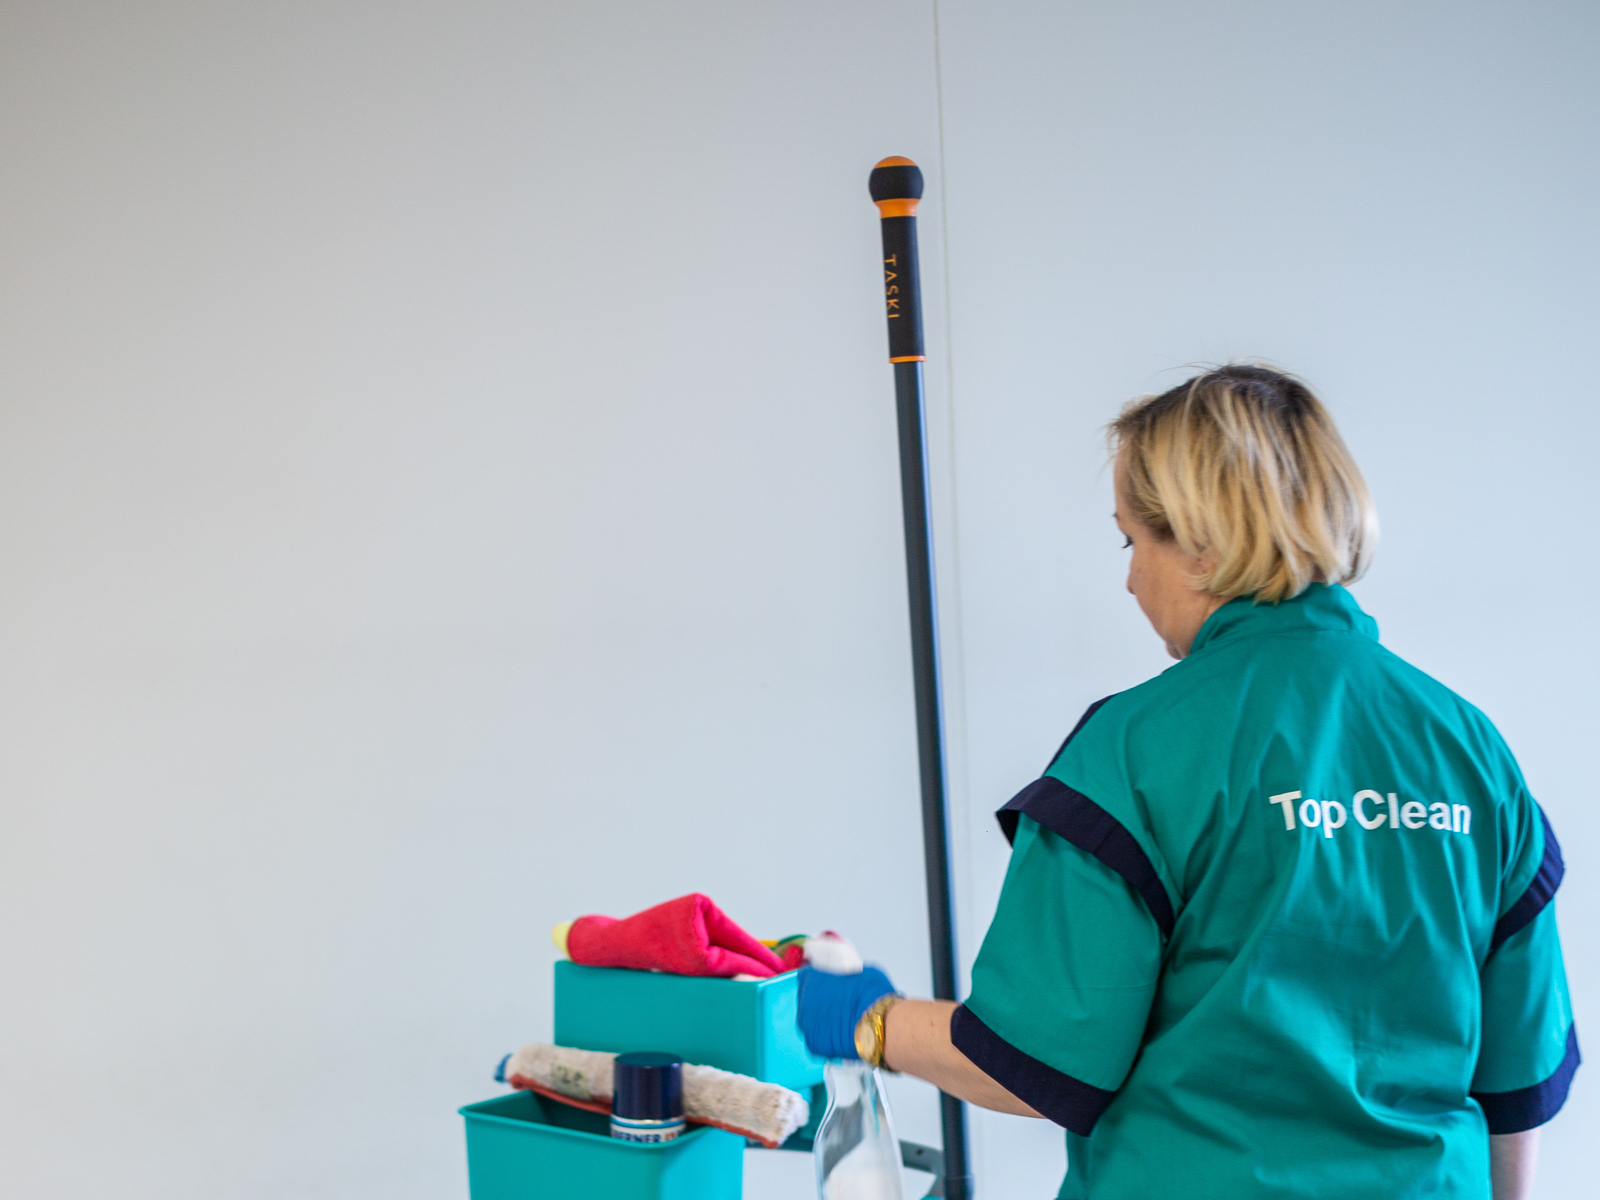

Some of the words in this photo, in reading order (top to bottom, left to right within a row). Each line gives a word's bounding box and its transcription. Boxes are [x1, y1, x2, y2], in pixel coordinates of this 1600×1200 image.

[884, 253, 900, 319] TASKI
[1269, 790, 1347, 838] Top
[1352, 789, 1471, 834] Clean
